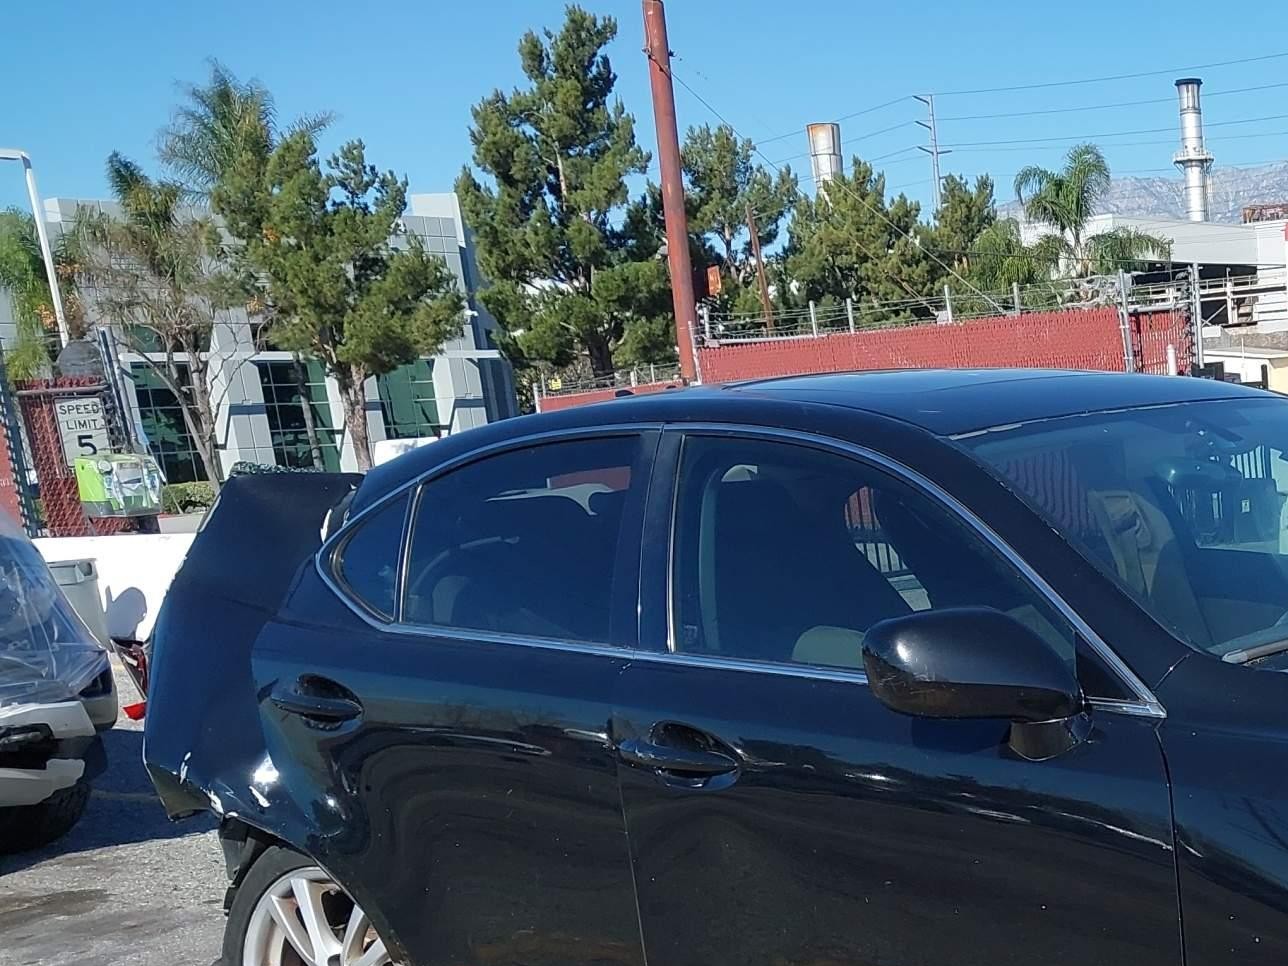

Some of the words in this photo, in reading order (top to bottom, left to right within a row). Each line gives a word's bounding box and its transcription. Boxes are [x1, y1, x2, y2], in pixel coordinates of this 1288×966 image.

[58, 403, 101, 415] SPEED
[65, 419, 98, 431] LIMIT
[77, 434, 98, 457] 5
